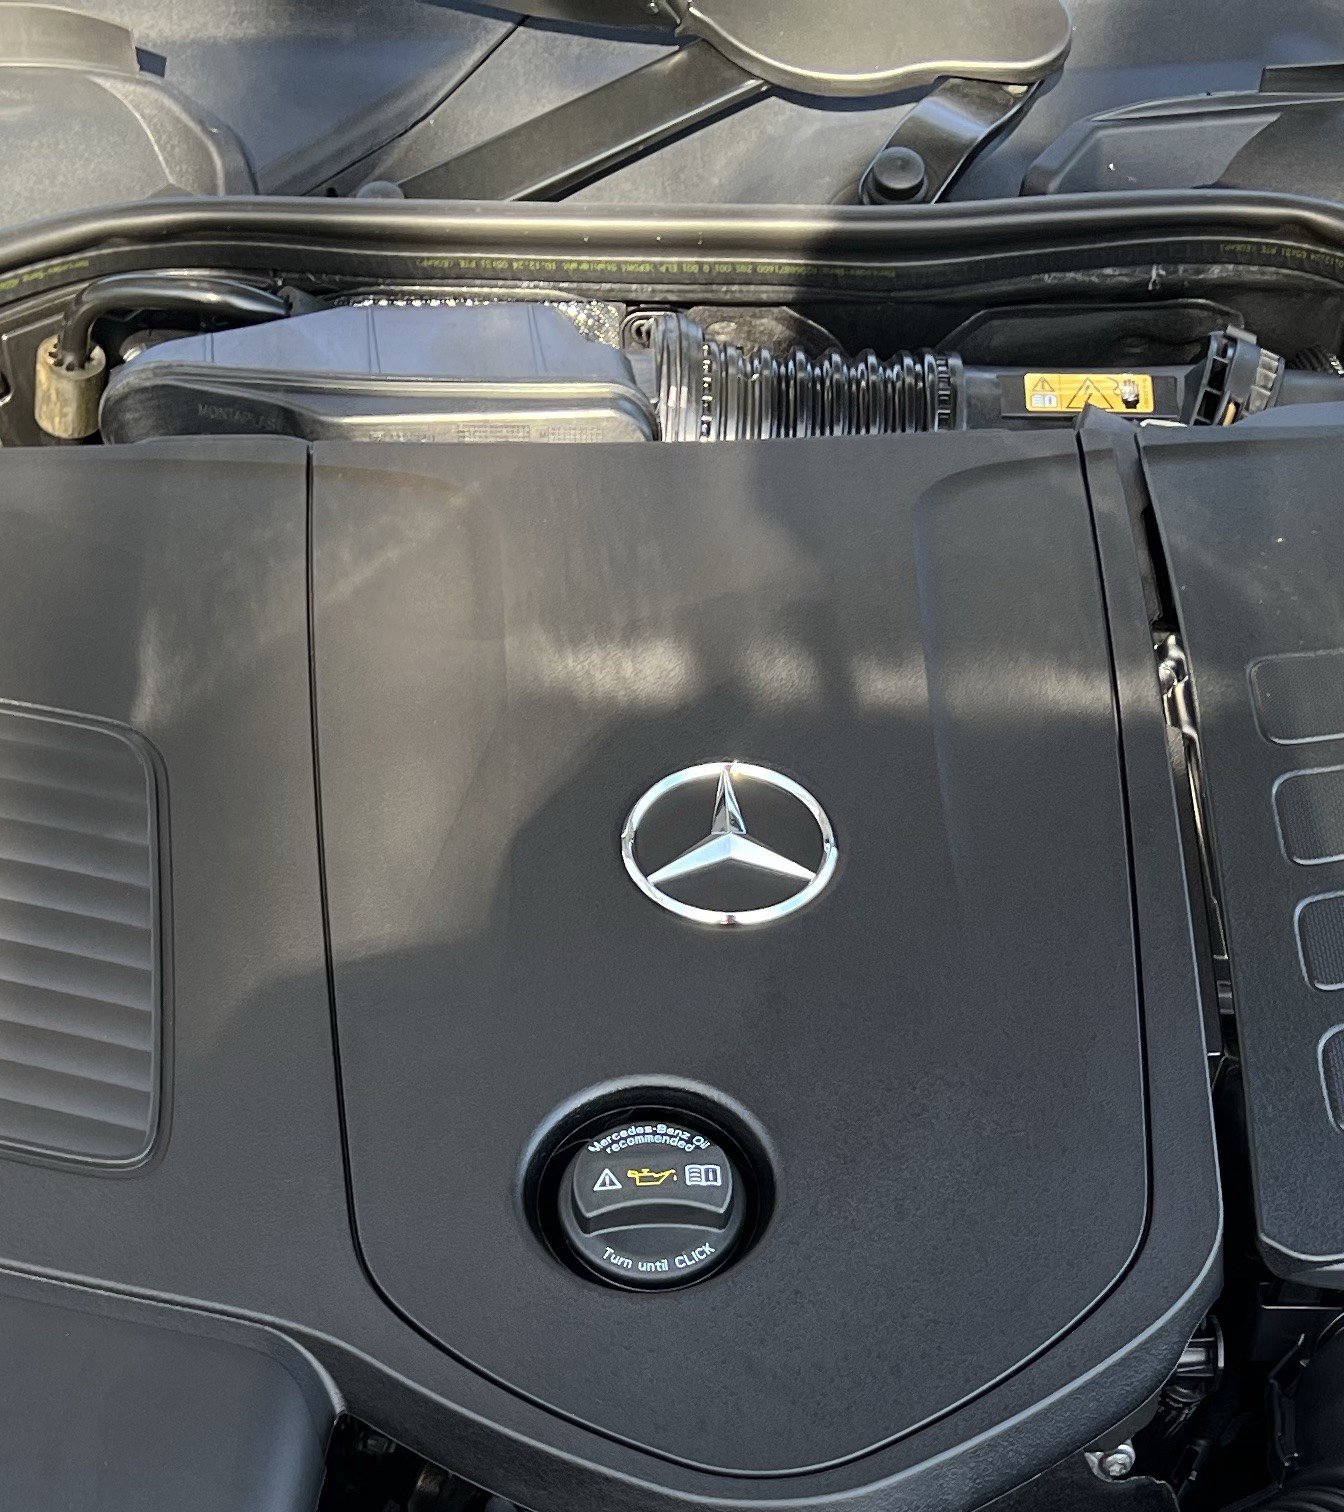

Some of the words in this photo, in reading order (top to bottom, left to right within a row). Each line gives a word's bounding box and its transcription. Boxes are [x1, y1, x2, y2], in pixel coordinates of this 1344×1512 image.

[588, 1123, 691, 1152] Mercedes-Benz
[692, 1135, 711, 1150] Oil
[605, 1134, 696, 1154] recommended
[602, 1247, 633, 1269] Turn
[638, 1258, 669, 1271] until
[674, 1242, 716, 1268] CLICK
